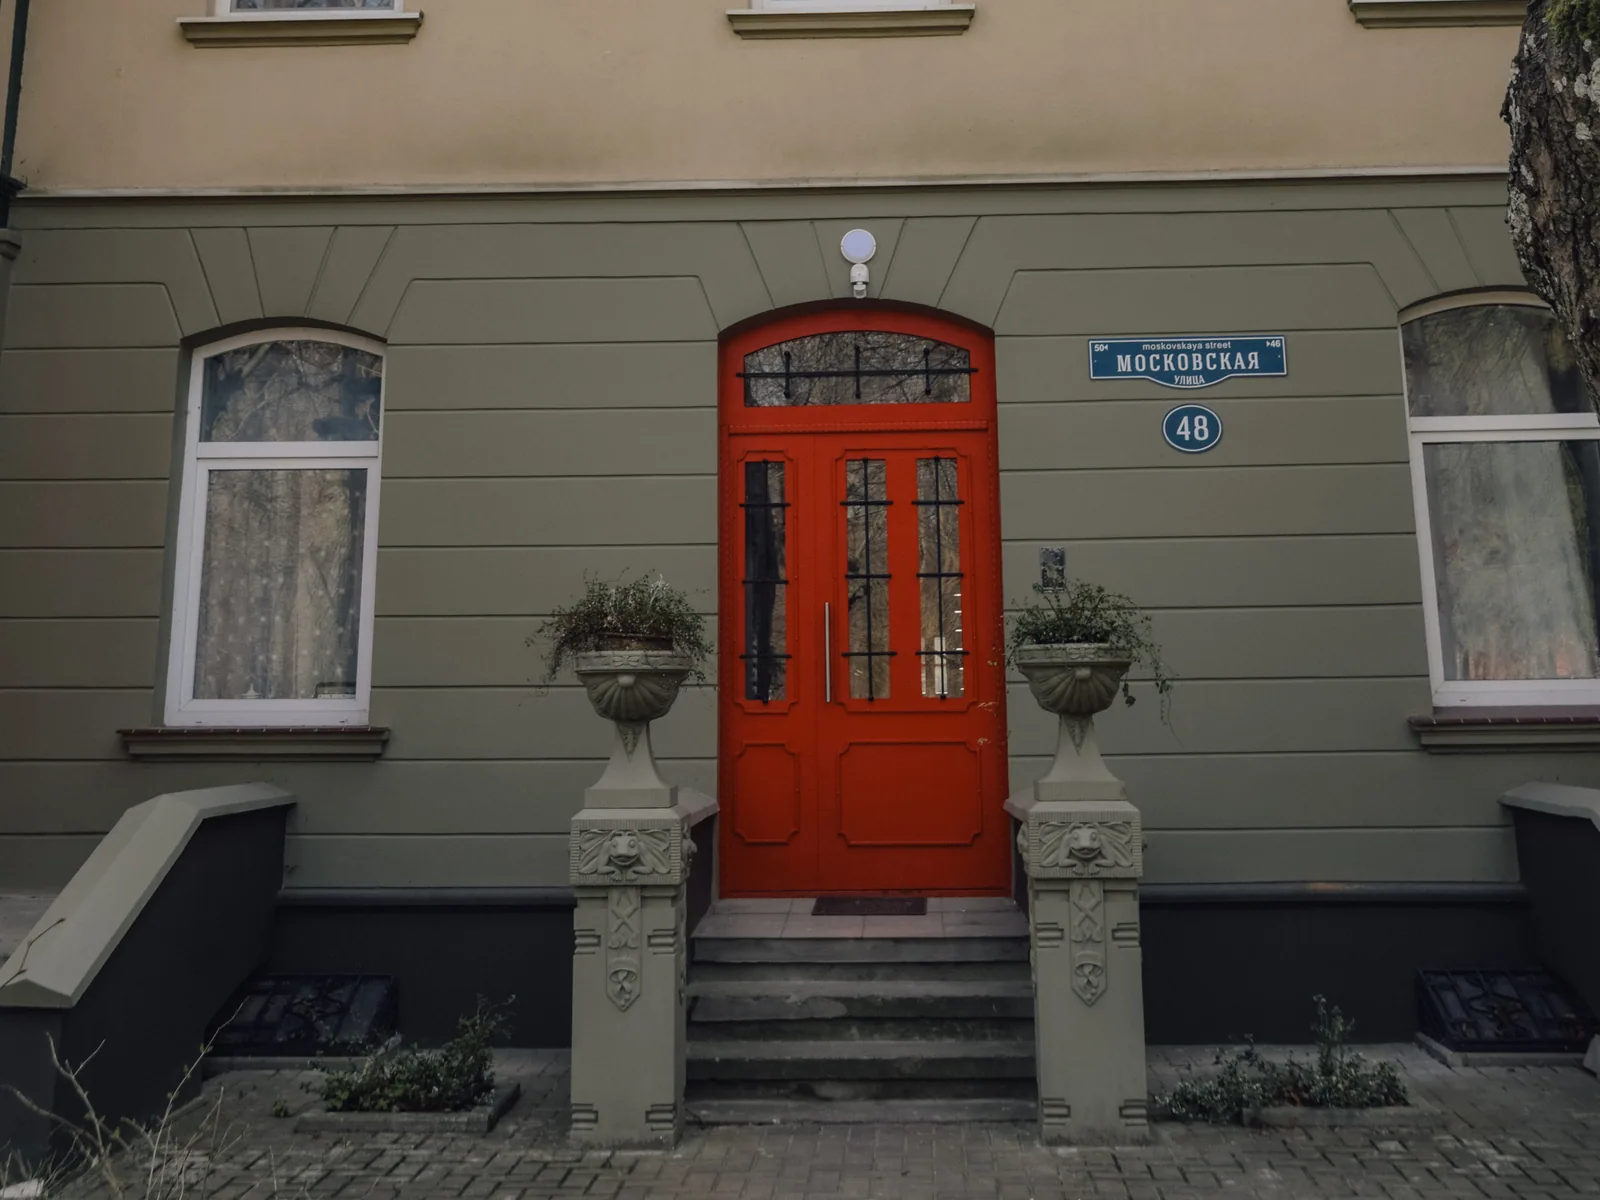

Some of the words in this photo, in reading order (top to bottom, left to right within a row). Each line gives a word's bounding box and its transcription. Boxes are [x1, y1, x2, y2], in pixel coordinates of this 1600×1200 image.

[1094, 343, 1104, 352] 50
[1142, 341, 1203, 351] moskovskaya
[1205, 341, 1232, 349] street
[1270, 340, 1281, 348] 46
[1116, 351, 1260, 372] МОСКОВСКАЯ
[1173, 374, 1205, 385] УЛИЦА
[1176, 415, 1209, 441] 48
